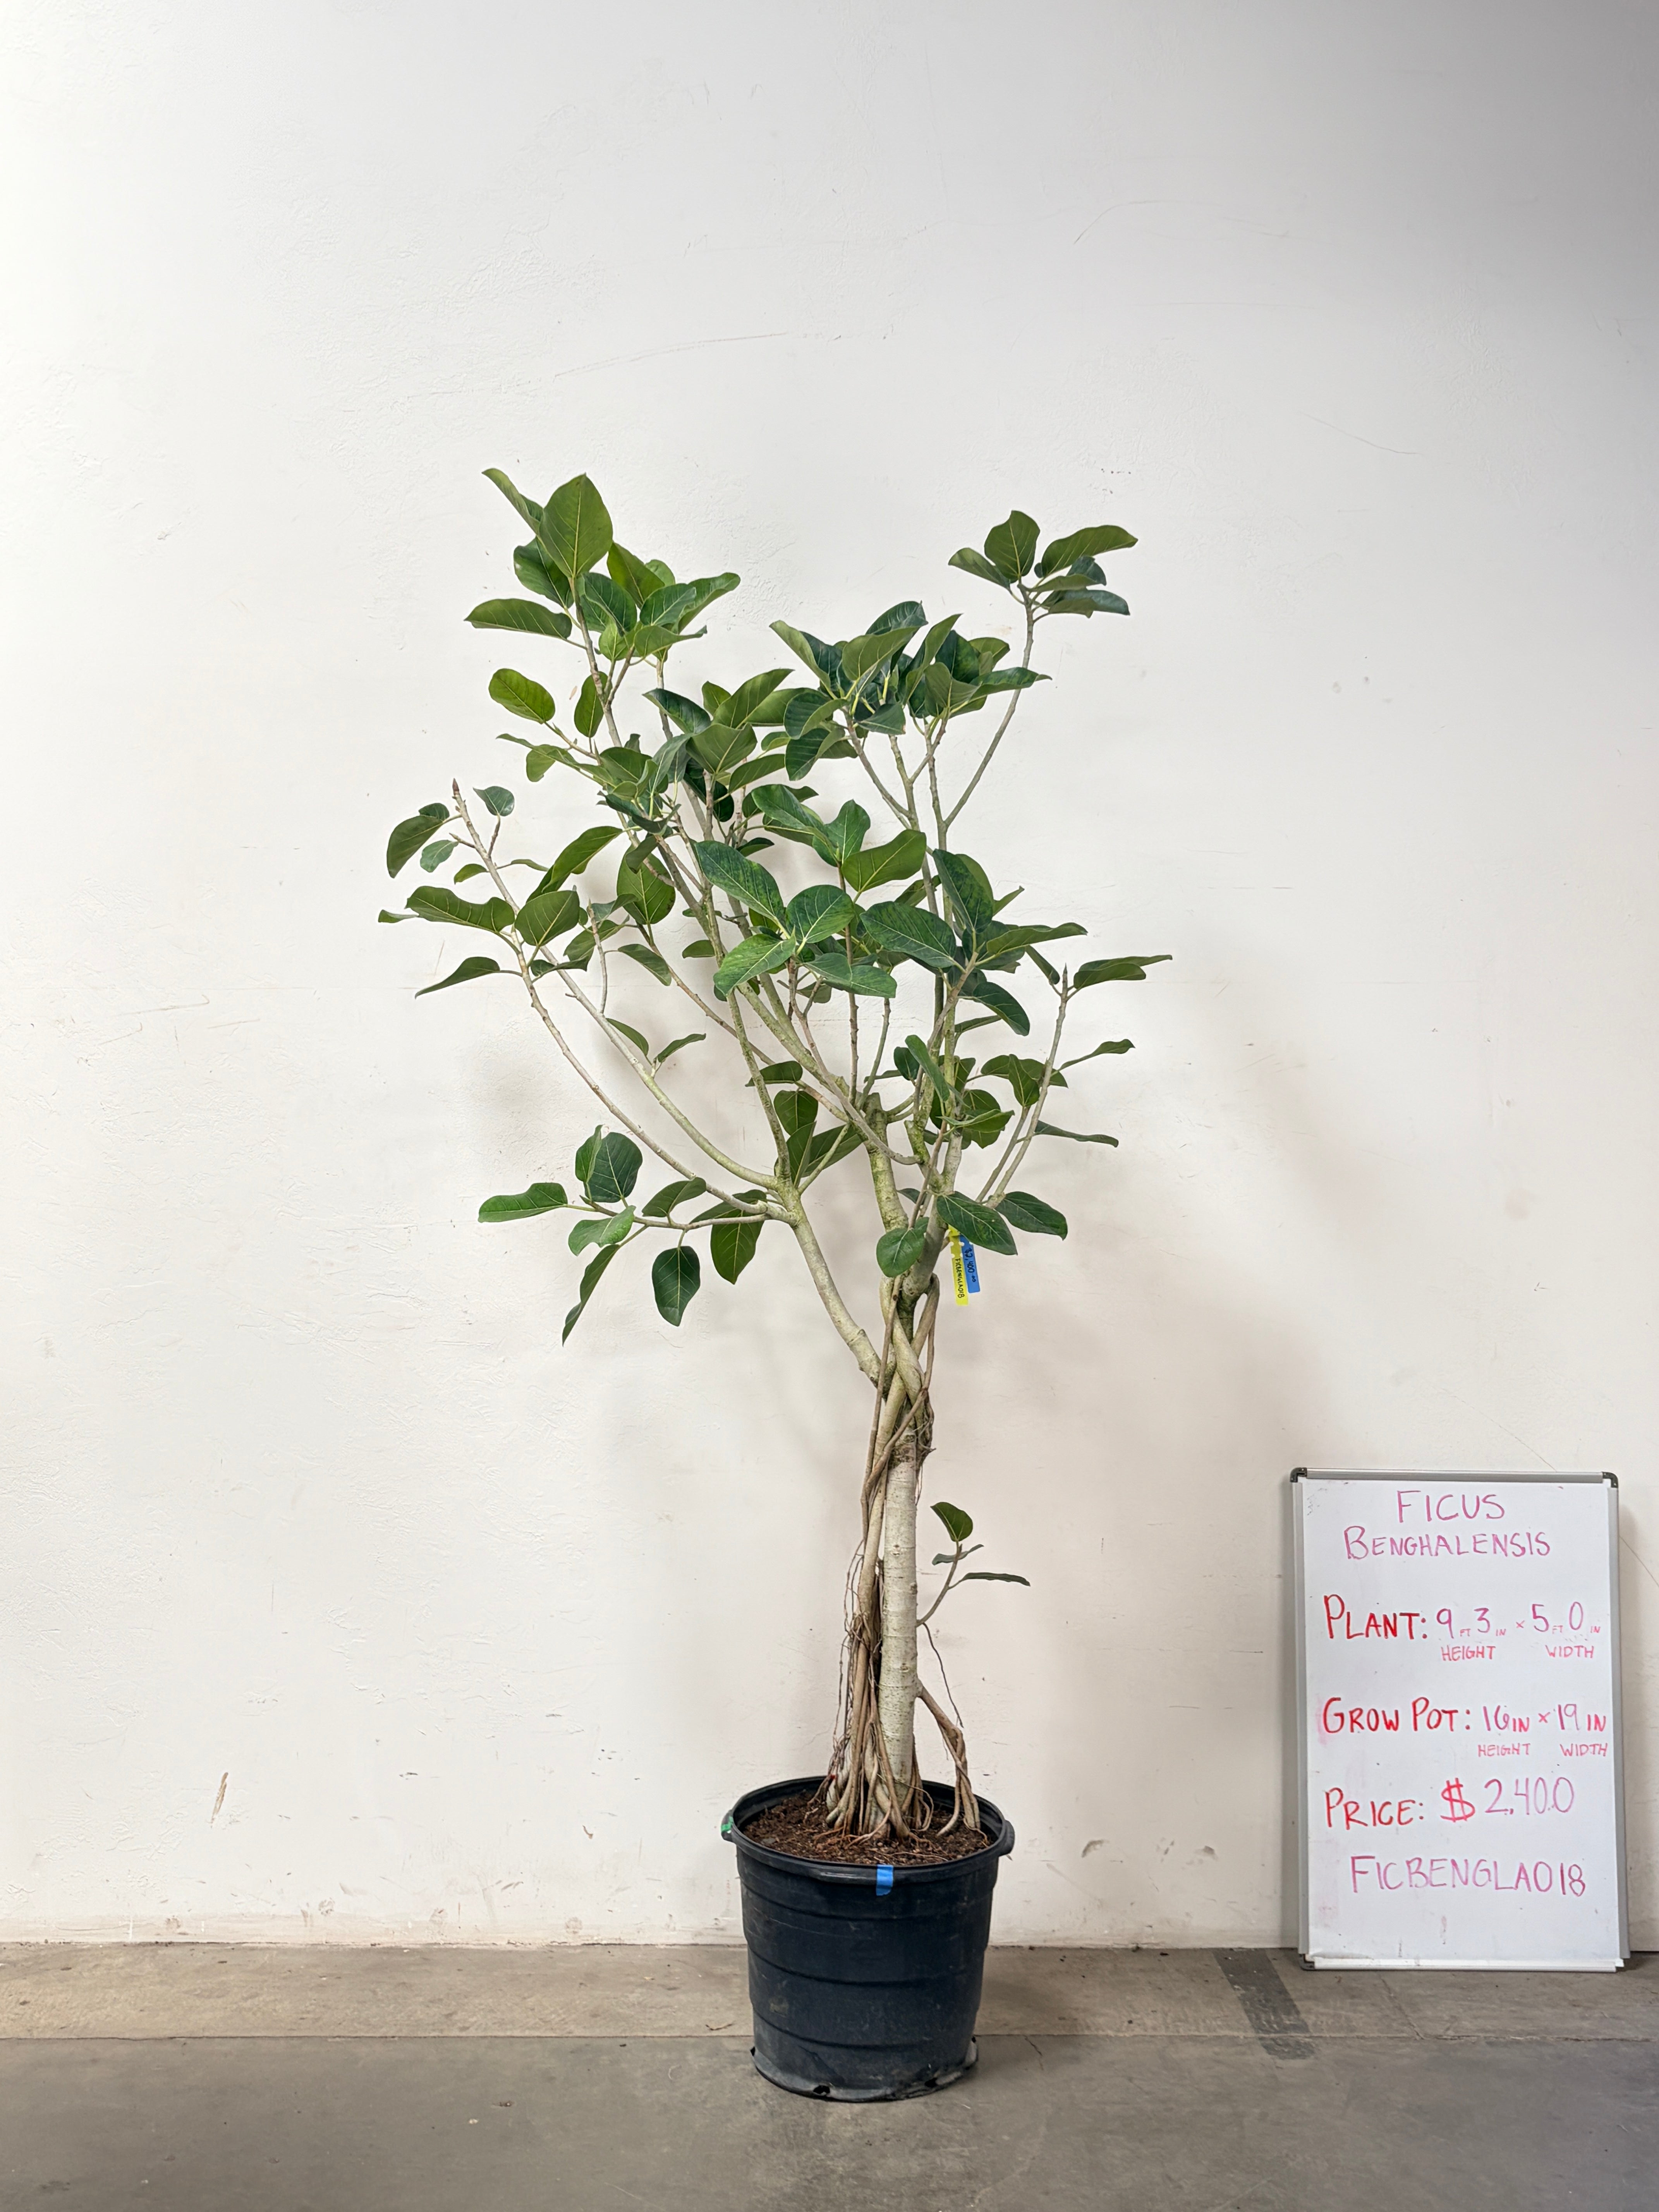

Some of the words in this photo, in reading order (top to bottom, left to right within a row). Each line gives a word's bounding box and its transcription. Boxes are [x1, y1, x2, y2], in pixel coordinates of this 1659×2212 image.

[1397, 1490, 1505, 1523] FICUS
[1343, 1525, 1551, 1560] BENGHALENSIS
[1323, 1594, 1427, 1640] PLANT:
[1436, 1608, 1454, 1638] 9
[1474, 1607, 1491, 1633] 3
[1532, 1604, 1549, 1632] 5
[1569, 1601, 1584, 1630] 0
[1441, 1645, 1496, 1661] HEIGHT
[1545, 1645, 1595, 1659] WIDTH
[1322, 1697, 1400, 1733] GROW
[1412, 1697, 1471, 1732] POT:
[1477, 1742, 1531, 1757] HEIGHT
[1559, 1743, 1608, 1757] WIDTH
[1325, 1787, 1424, 1831] PRICE:
[1351, 1855, 1586, 1897] FICBENGLA018
